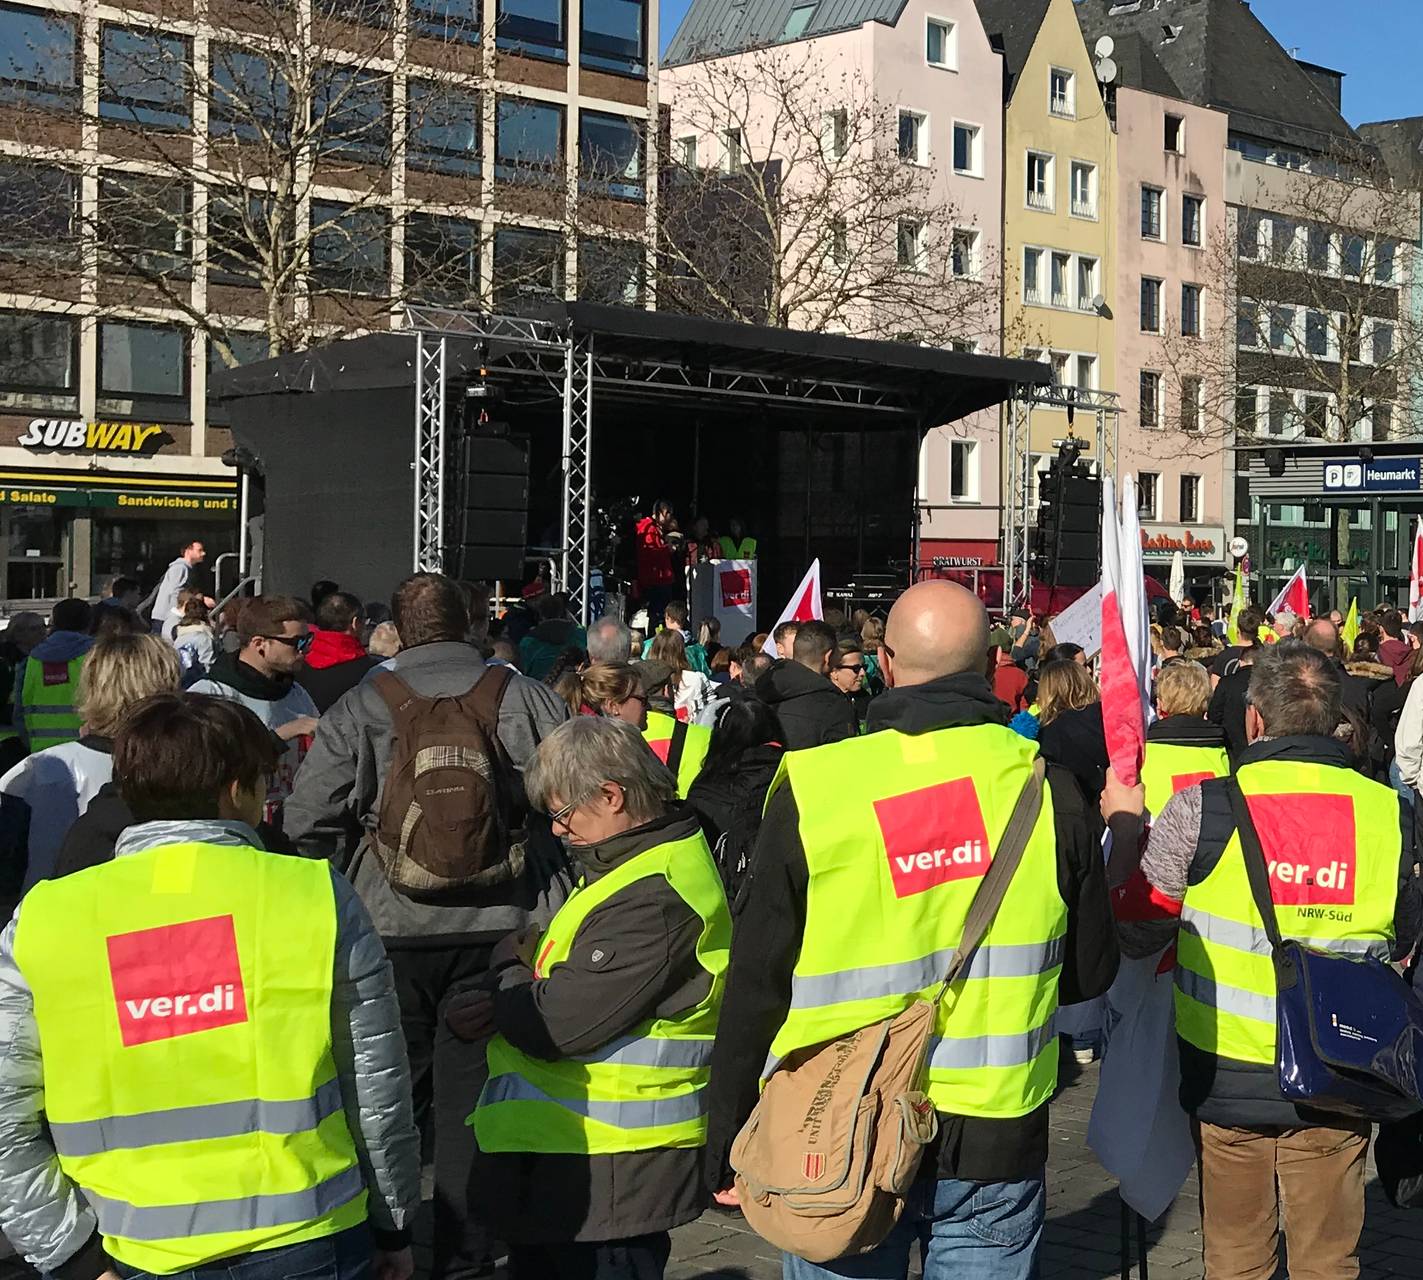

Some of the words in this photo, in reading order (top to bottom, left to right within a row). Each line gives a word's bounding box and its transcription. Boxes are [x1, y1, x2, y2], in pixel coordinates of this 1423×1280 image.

[17, 418, 163, 451] SUBWAY
[1367, 468, 1416, 481] Heumarkt
[10, 490, 57, 503] Salate
[118, 495, 199, 509] Sandwiches
[204, 498, 229, 509] und
[895, 840, 983, 874] ver.di
[1296, 907, 1353, 923] NRW-Süd
[125, 984, 235, 1020] ver.di
